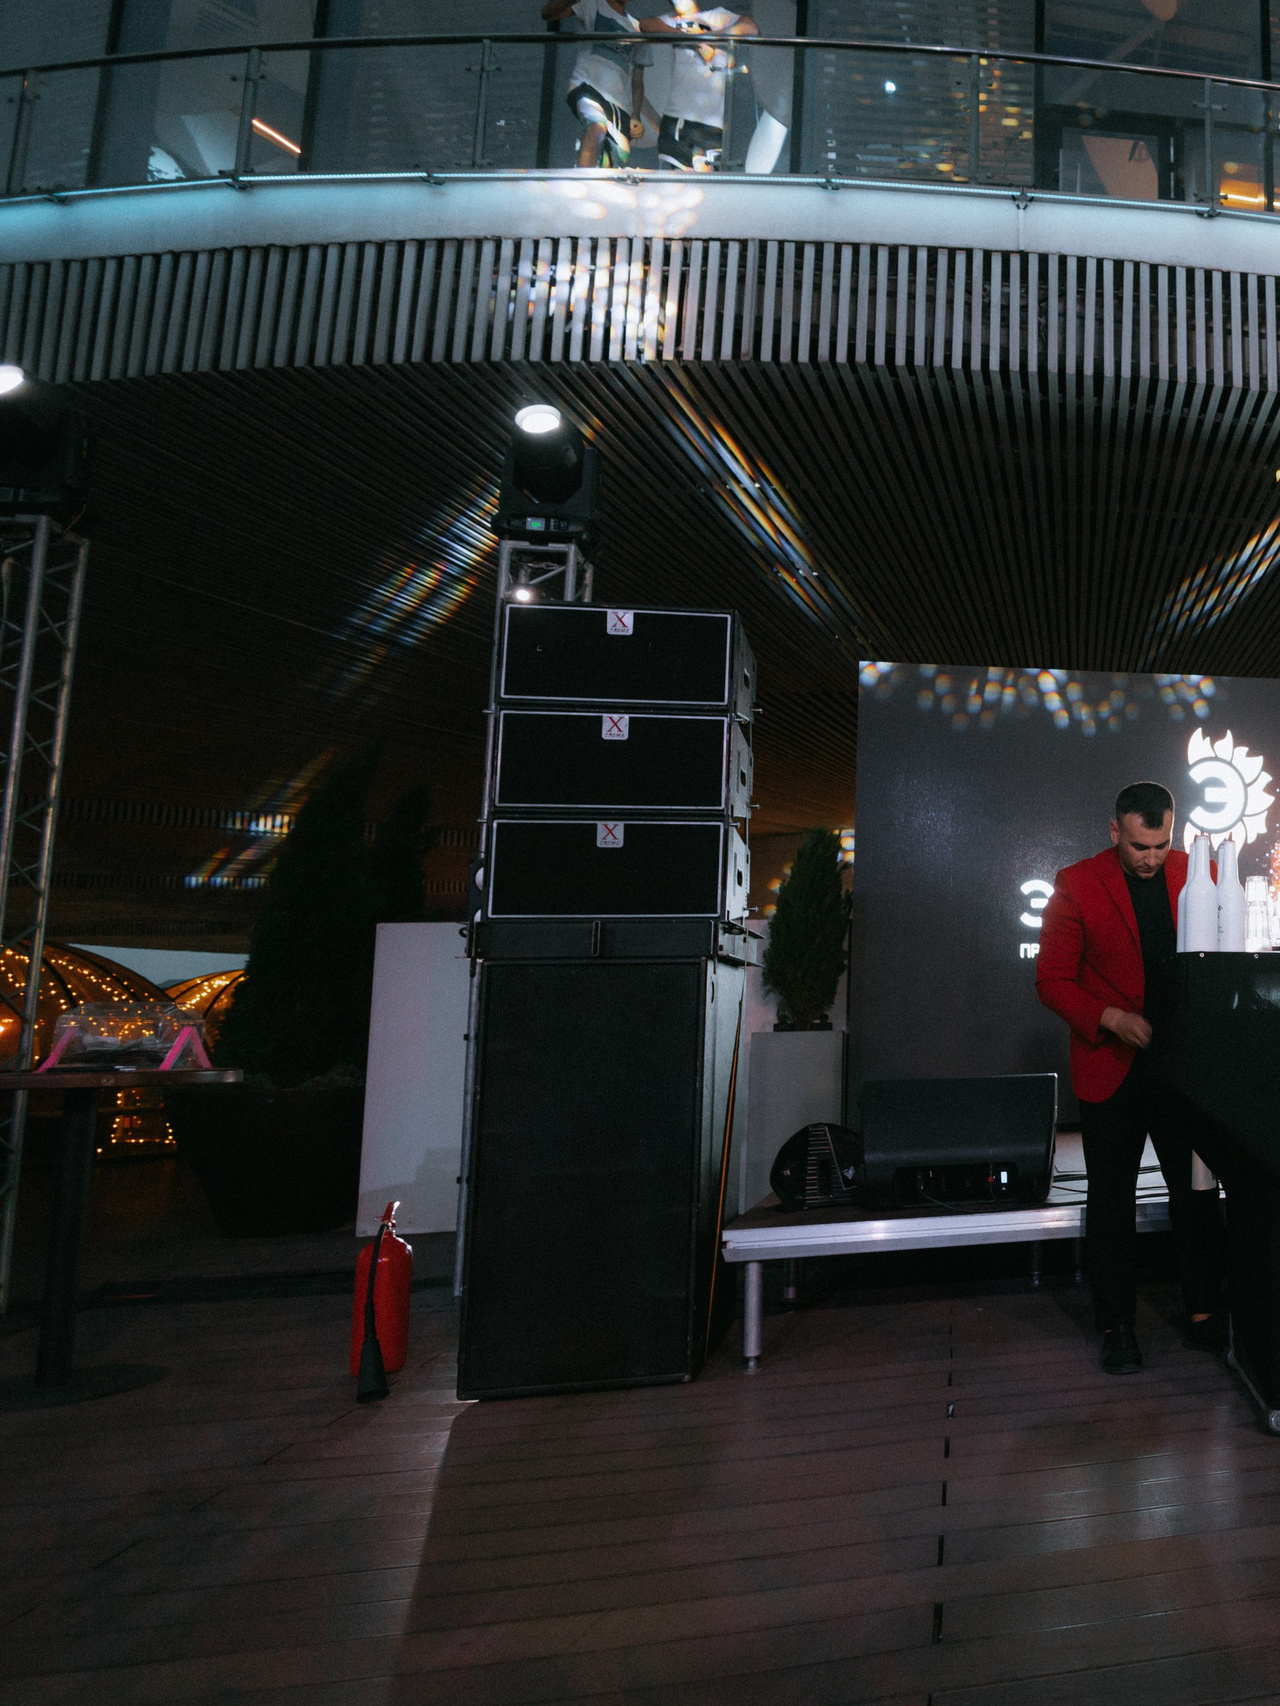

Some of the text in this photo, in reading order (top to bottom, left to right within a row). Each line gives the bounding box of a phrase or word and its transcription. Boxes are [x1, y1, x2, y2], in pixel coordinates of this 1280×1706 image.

[611, 611, 629, 628] X
[606, 716, 625, 732] X
[601, 823, 620, 840] X
[1020, 880, 1055, 928] Э
[1020, 943, 1041, 959] ПР
